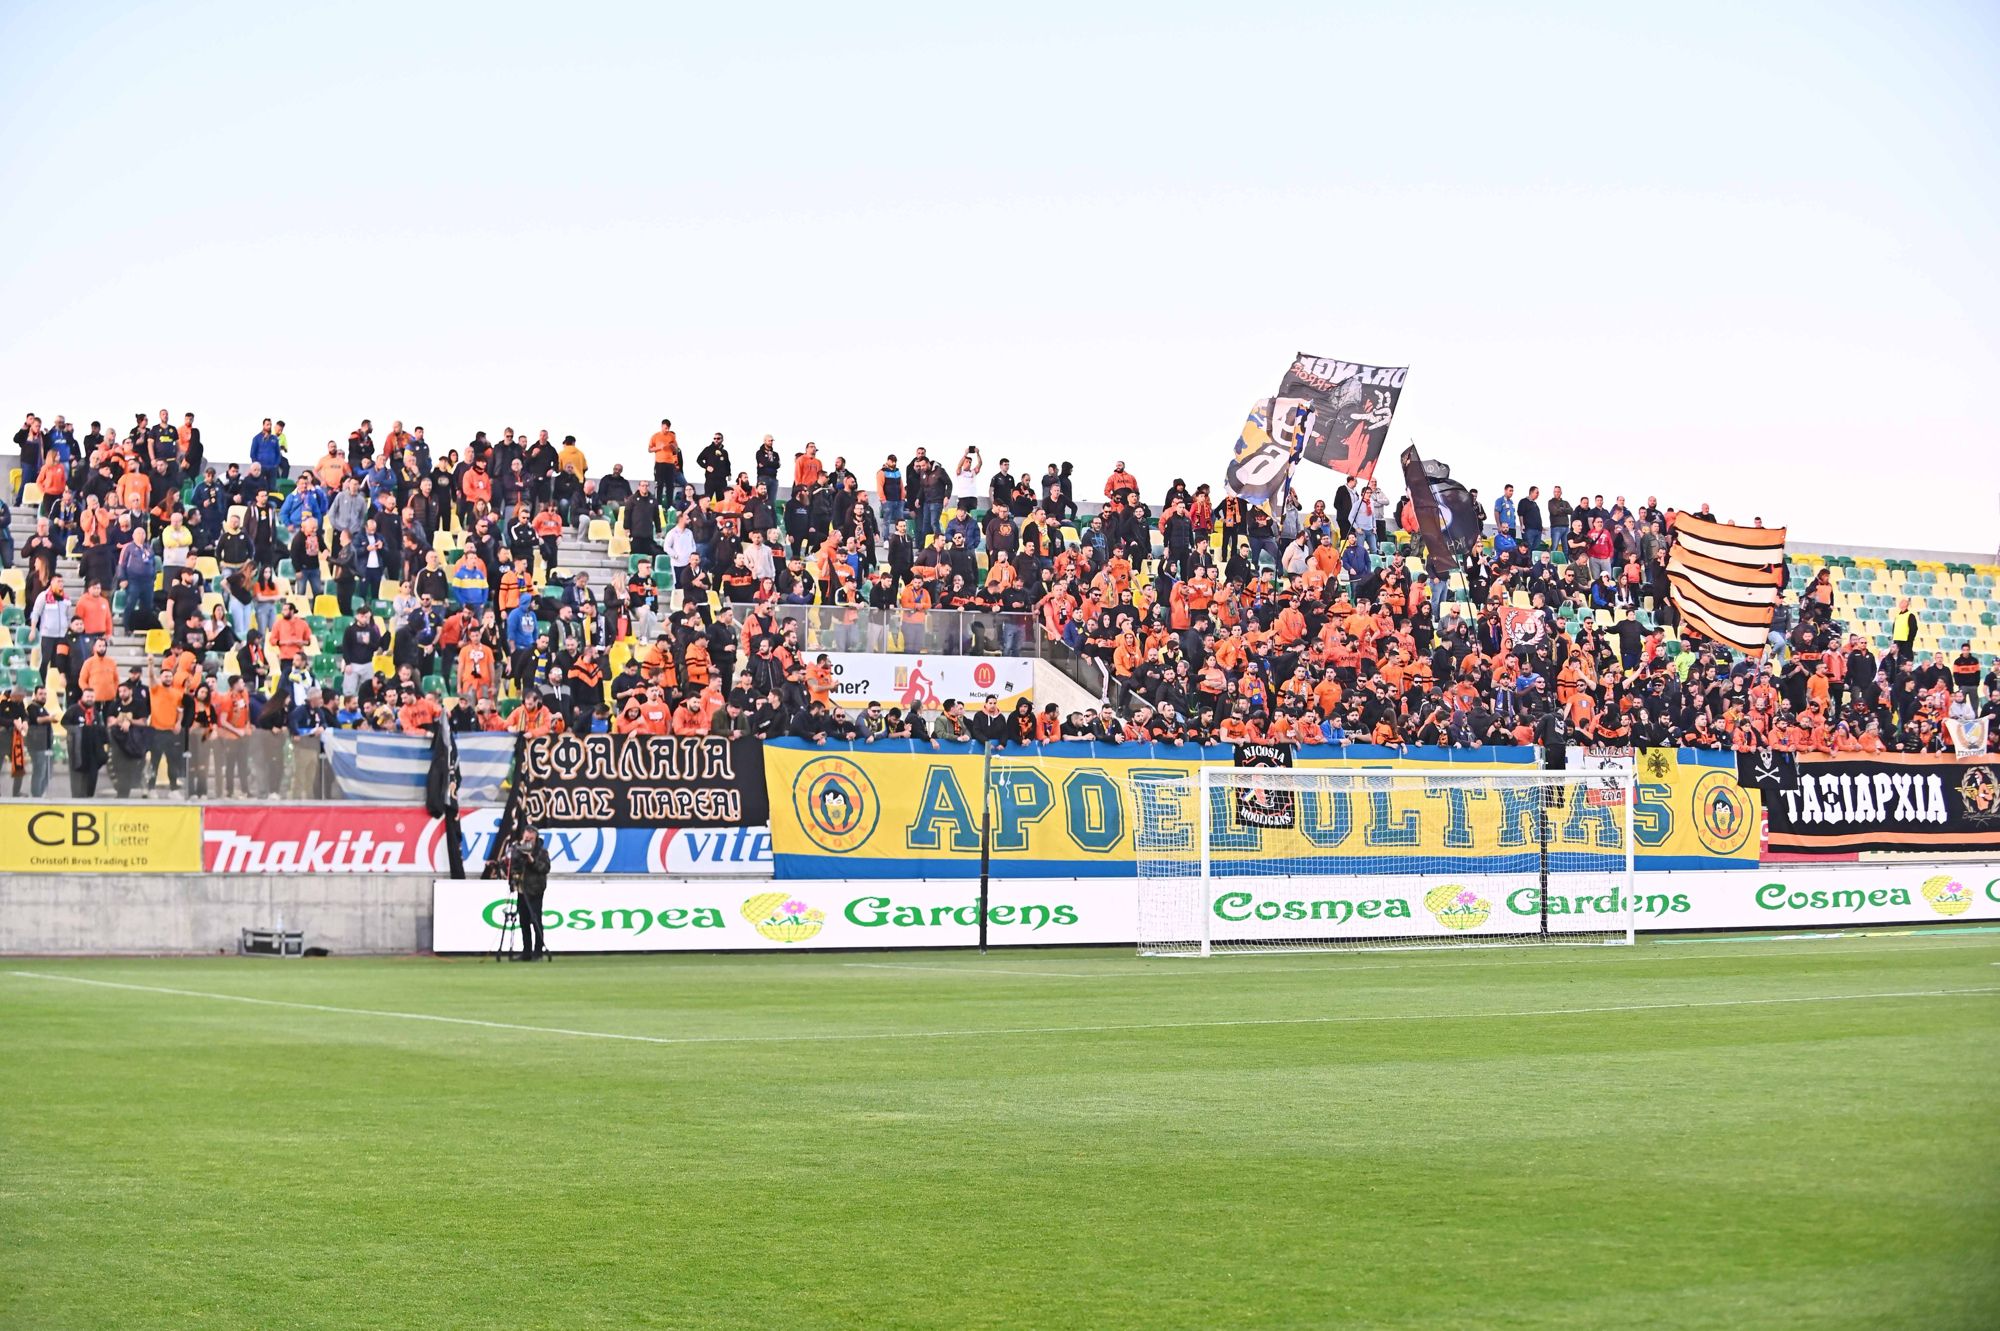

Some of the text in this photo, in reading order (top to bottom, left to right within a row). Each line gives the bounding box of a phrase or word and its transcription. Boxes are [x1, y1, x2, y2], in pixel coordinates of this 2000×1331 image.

[830, 679, 870, 694] ner?
[1243, 745, 1285, 763] NICOSIA
[906, 764, 1676, 853] APOEL ULTRAS
[1241, 806, 1292, 826] HOOLIGANS
[1779, 772, 1948, 825] ΤΑΞΙΑΡΧΙΑ
[27, 811, 100, 846] CB
[684, 825, 773, 862] vite
[30, 856, 148, 867] Christofi Bros Trading LTD
[1213, 887, 1691, 925] Cosmea Gardens
[1755, 883, 1912, 912] Cosmea
[482, 897, 1079, 936] Cosmea Gardens
